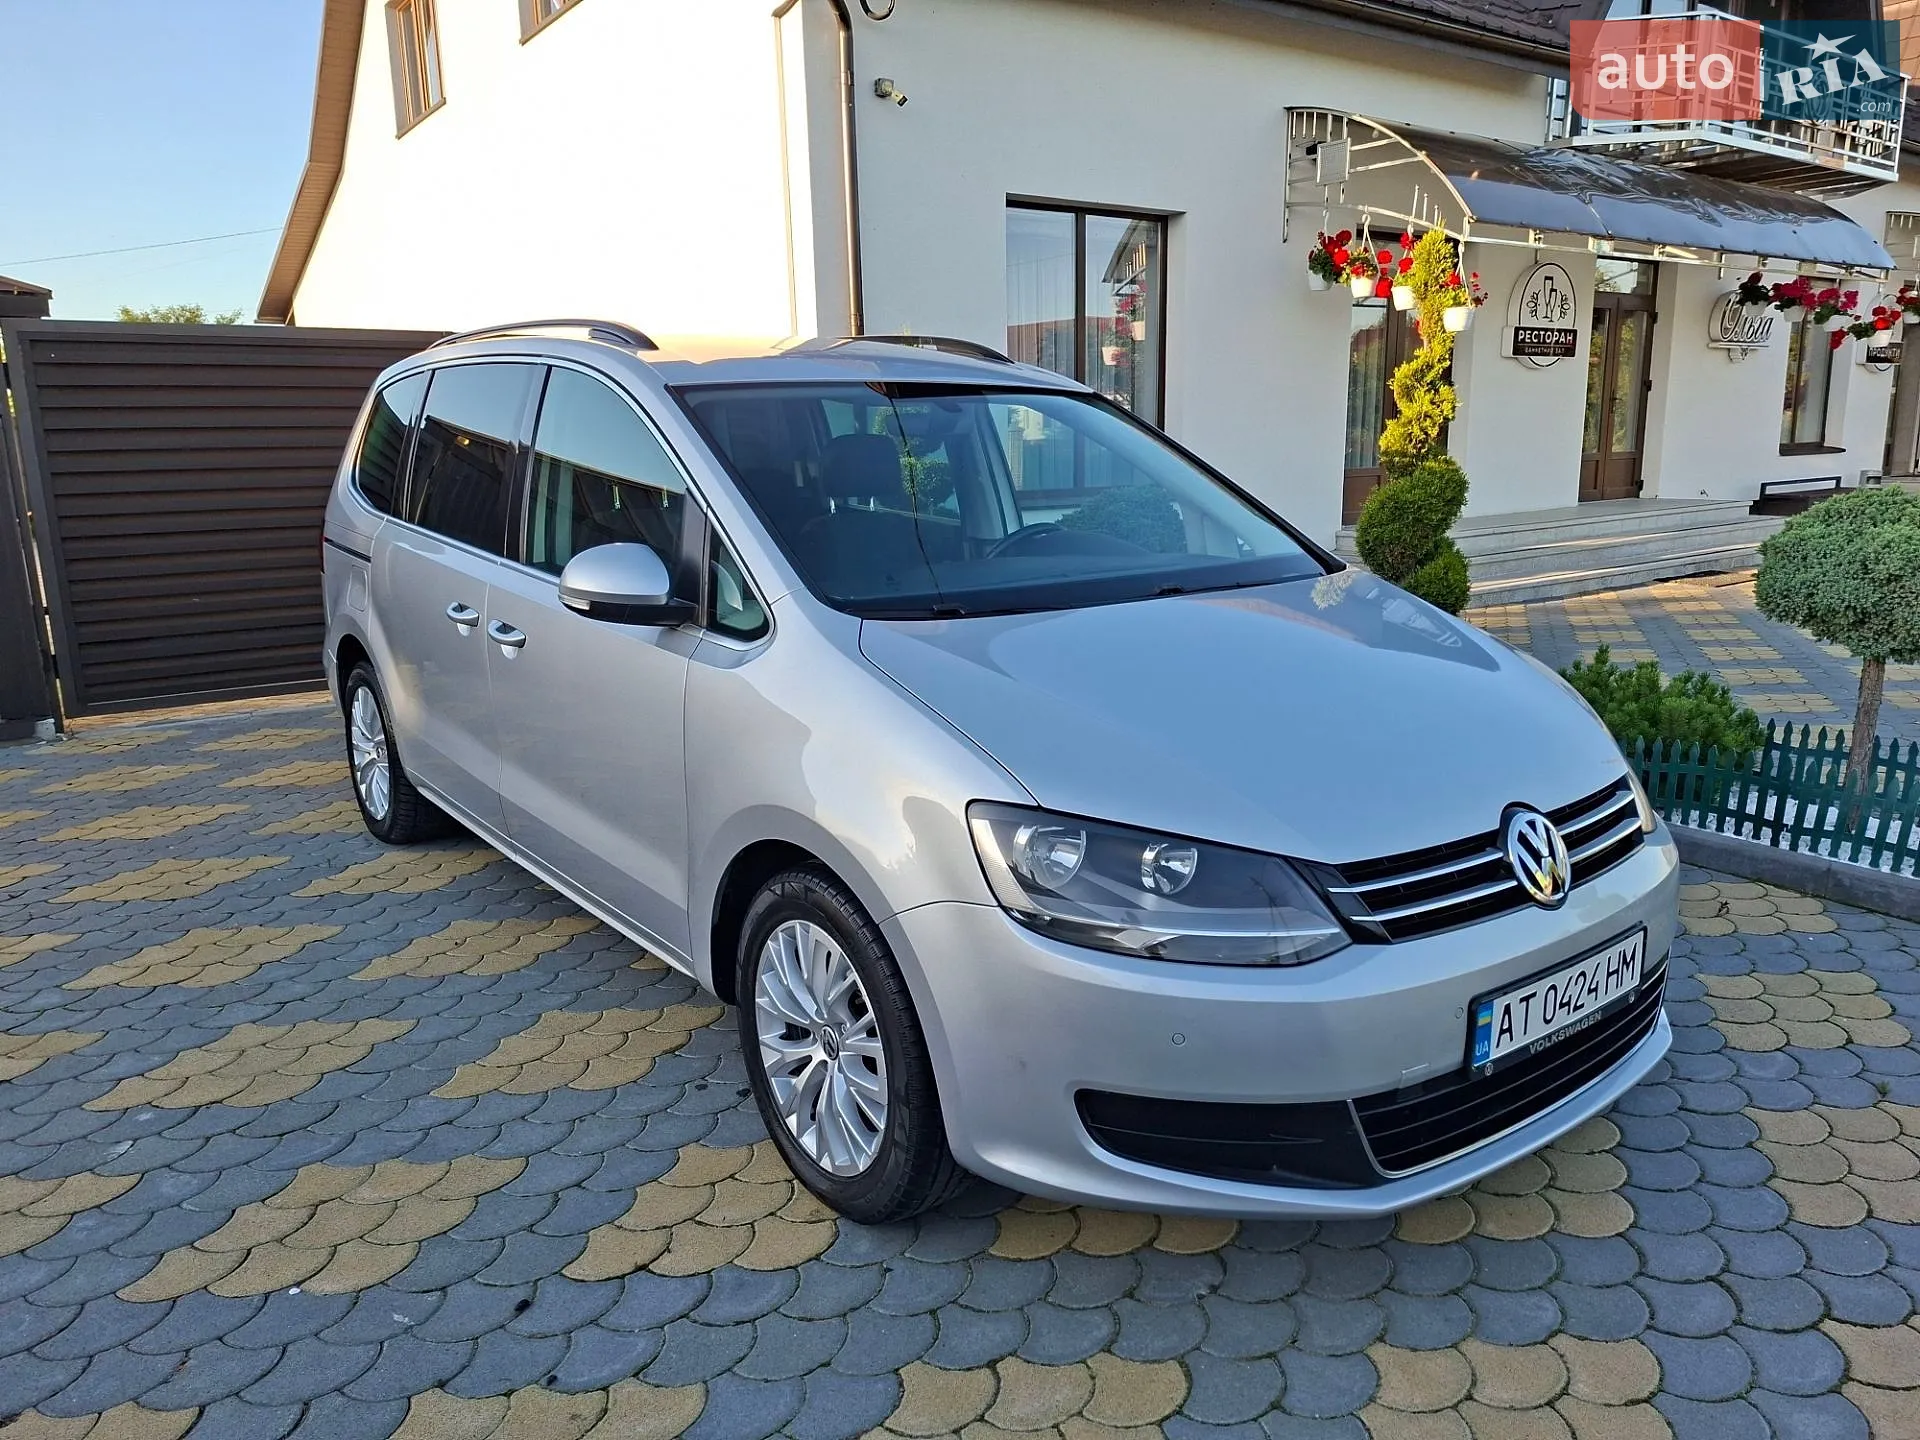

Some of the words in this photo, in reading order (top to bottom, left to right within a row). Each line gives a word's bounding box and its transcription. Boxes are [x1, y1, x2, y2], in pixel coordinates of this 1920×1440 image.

[1518, 330, 1574, 344] РЕСТОРАН
[1496, 991, 1537, 1049] AT
[1542, 962, 1600, 1025] 0424
[1604, 942, 1638, 996] HM
[1529, 1010, 1603, 1055] VOLKSWAGEN
[1475, 1040, 1489, 1056] UA
